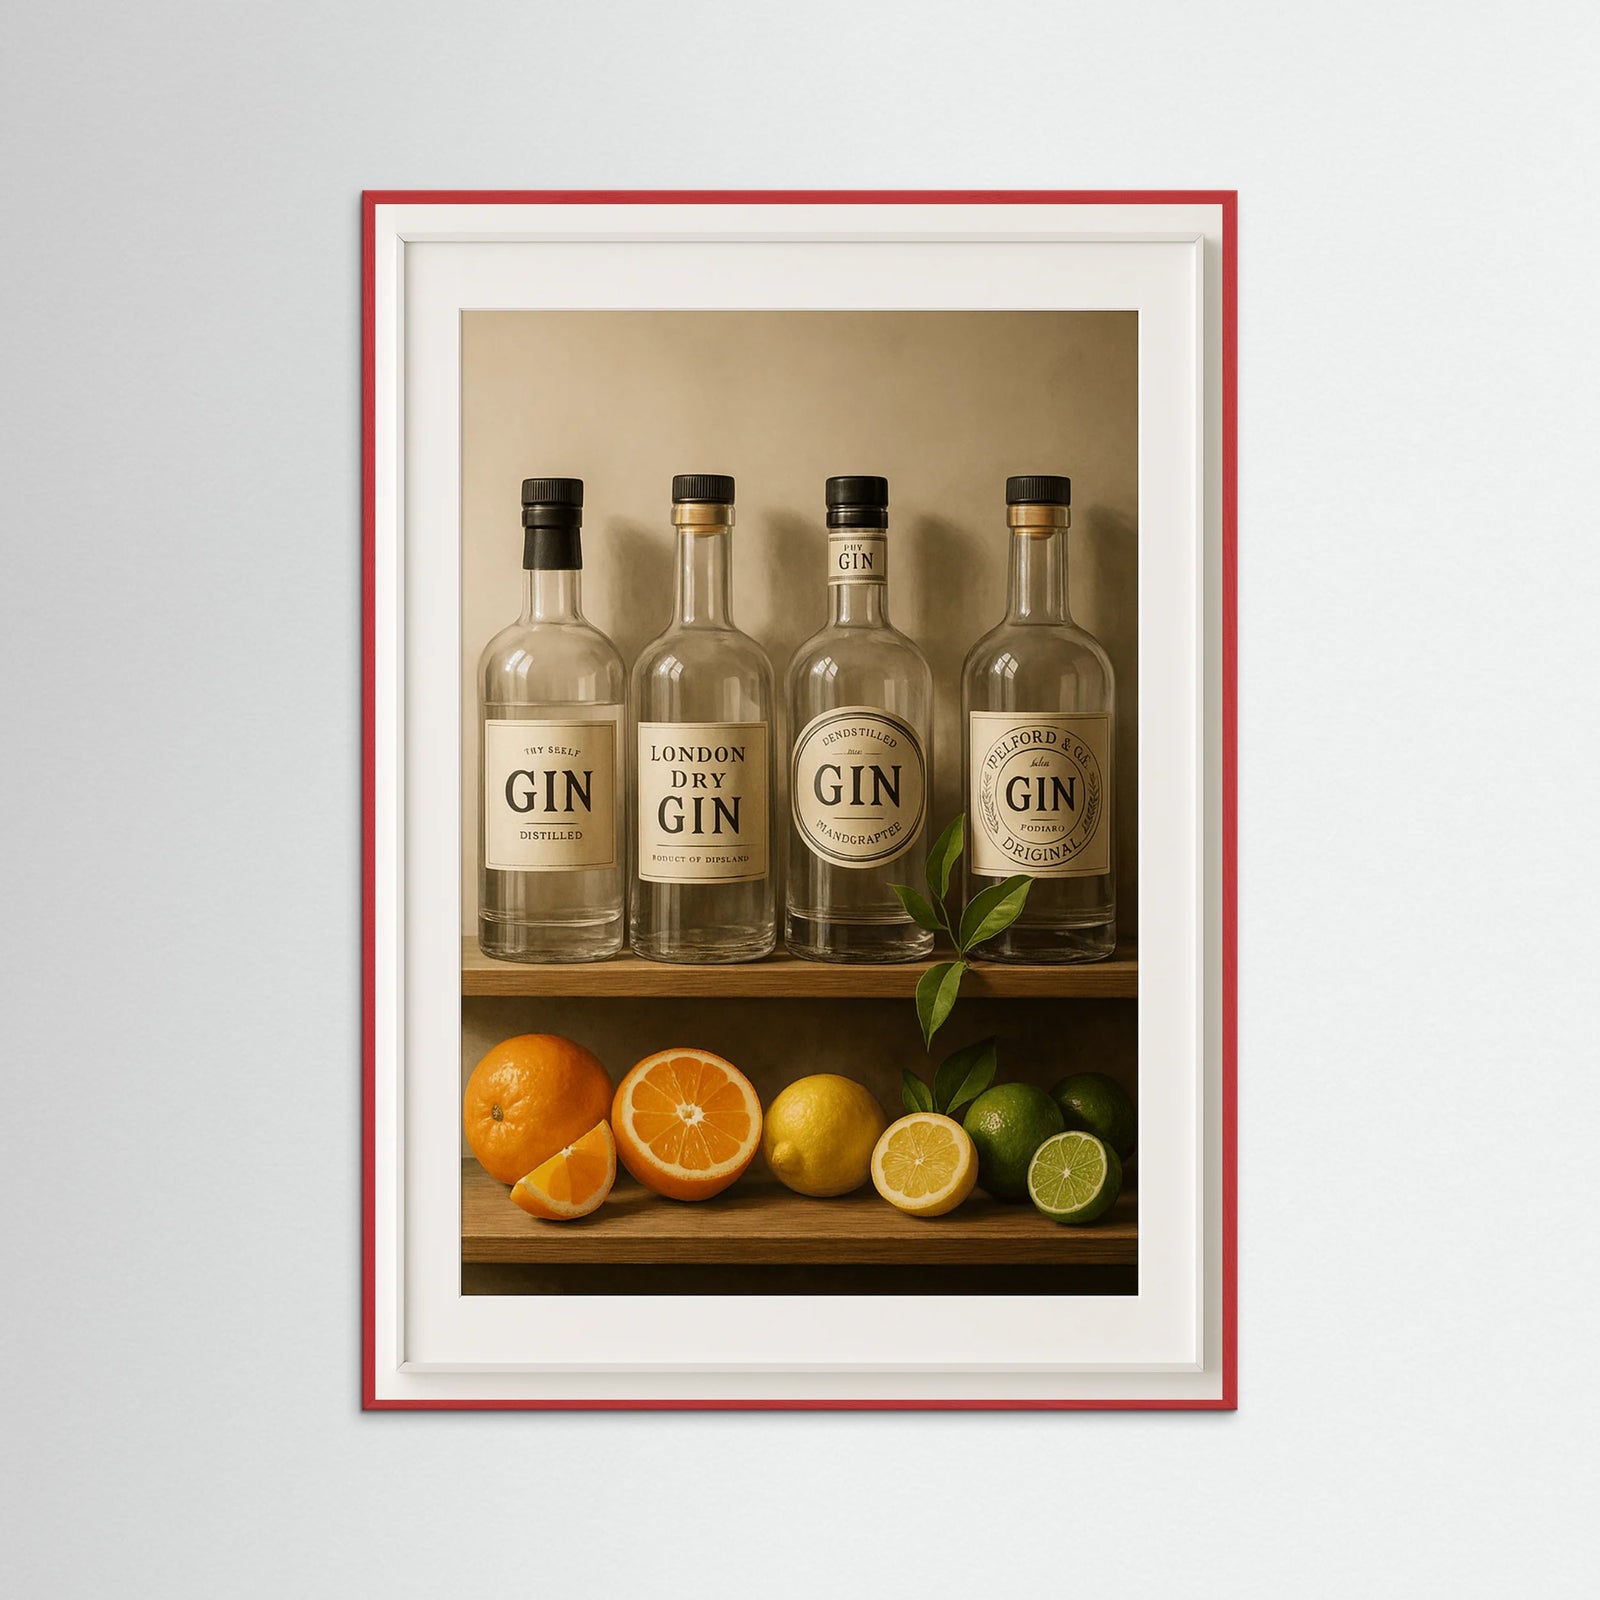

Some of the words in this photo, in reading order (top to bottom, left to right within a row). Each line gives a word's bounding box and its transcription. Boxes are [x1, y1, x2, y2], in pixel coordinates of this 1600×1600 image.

[838, 552, 874, 570] GIN
[822, 727, 898, 748] DENDSTILLED
[1061, 737, 1071, 752] &
[650, 745, 746, 763] LONDON
[671, 769, 727, 789] DRY
[813, 763, 903, 809] GIN
[505, 769, 594, 813] GIN
[1005, 775, 1077, 812] GIN
[657, 795, 742, 835] GIN
[519, 830, 583, 840] DISTILLED
